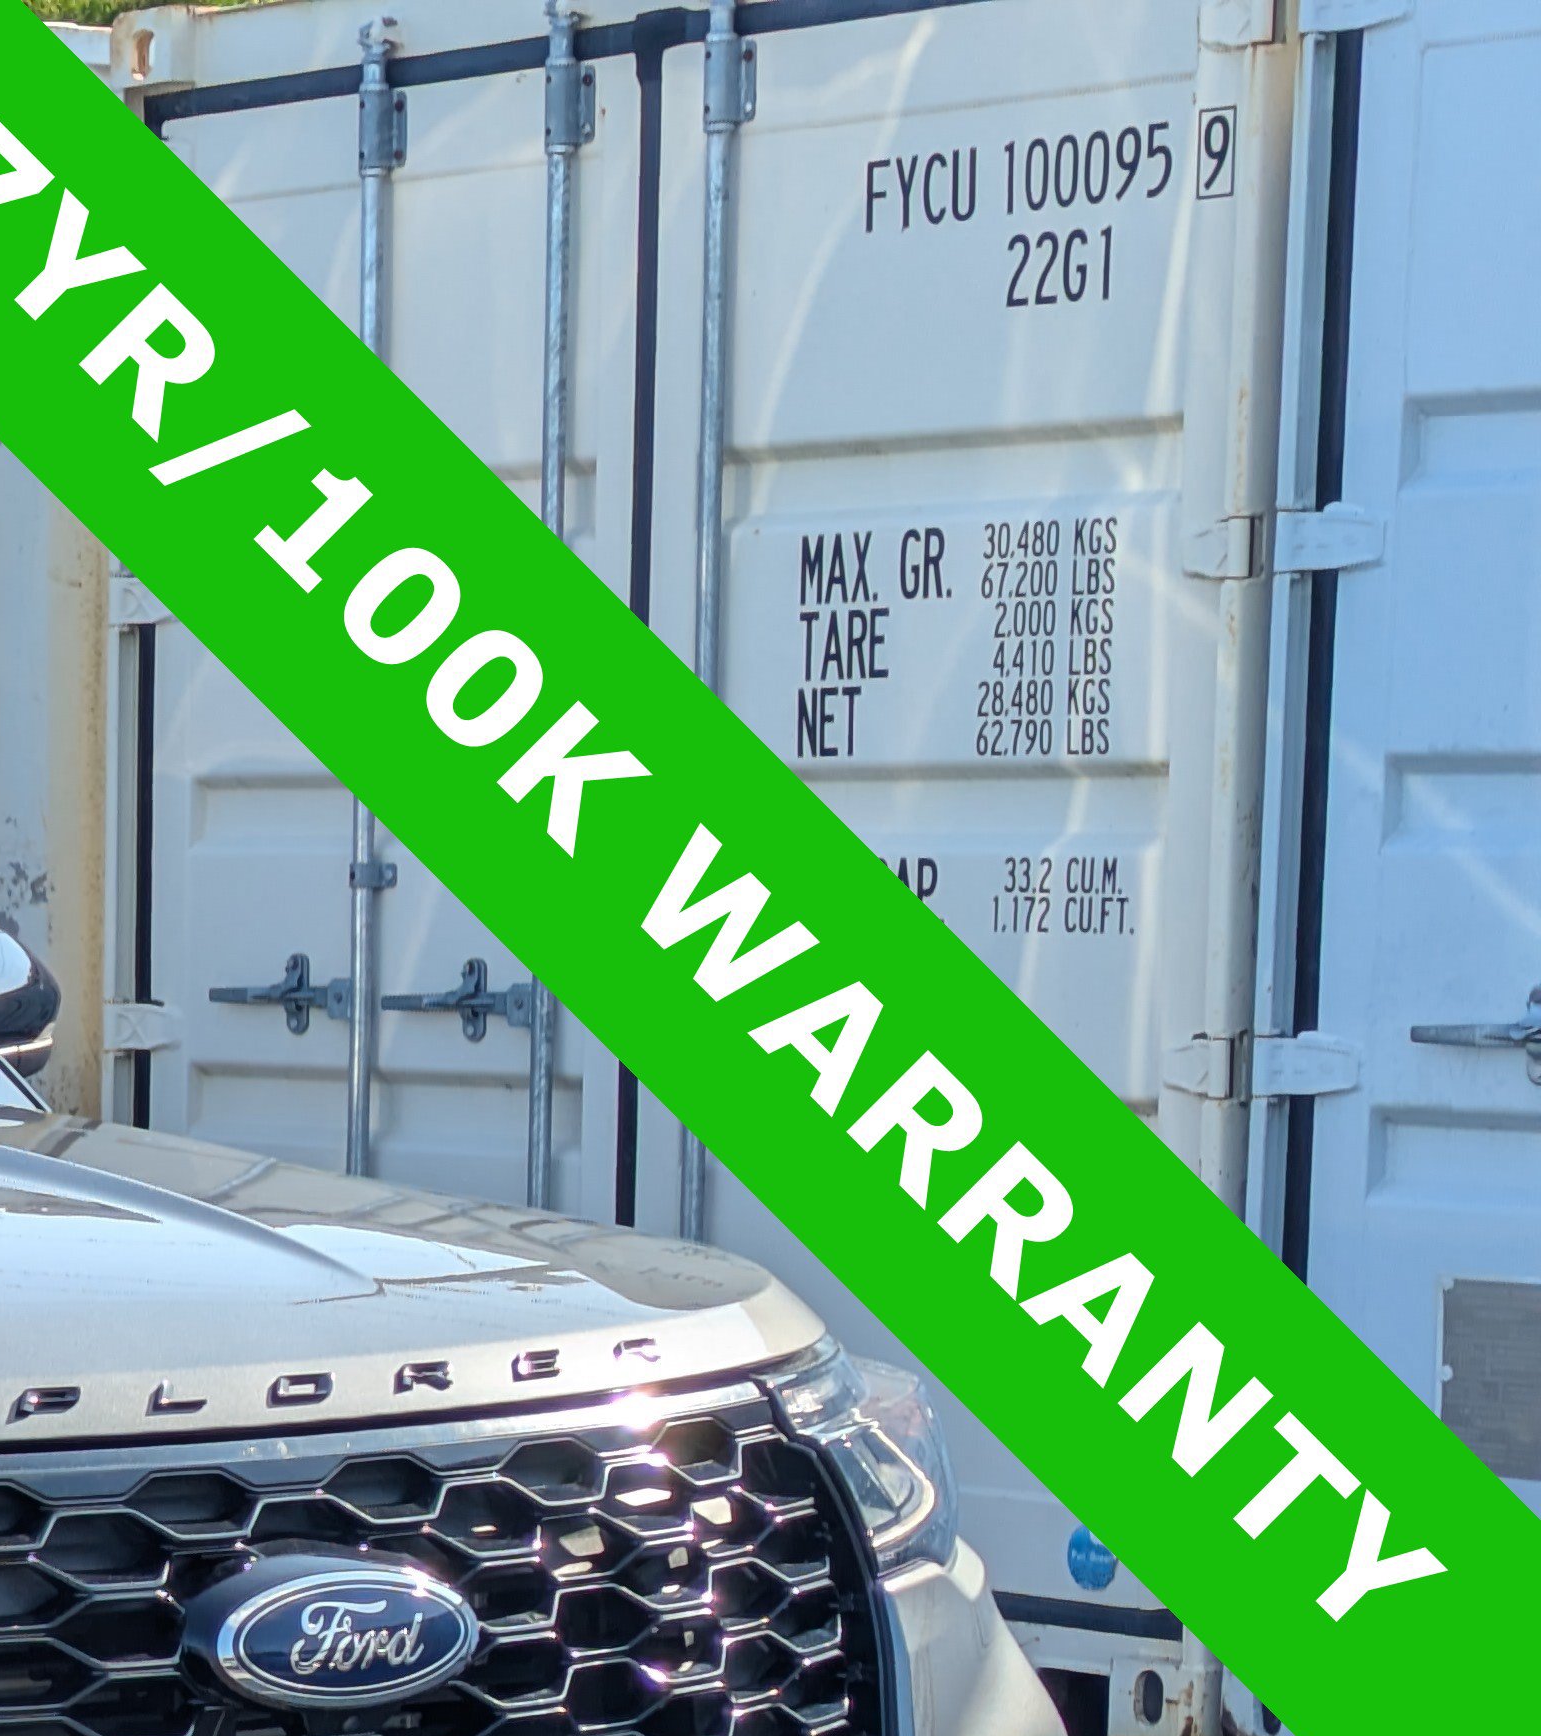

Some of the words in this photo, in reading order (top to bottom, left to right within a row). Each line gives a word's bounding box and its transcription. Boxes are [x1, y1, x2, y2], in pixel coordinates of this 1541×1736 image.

[865, 147, 978, 233] FYCU
[1003, 121, 1173, 216] 100095
[1204, 115, 1230, 191] 9
[1005, 225, 1113, 308] 22G1
[799, 530, 879, 607] MAX.
[899, 526, 953, 600] GR.
[1072, 516, 1118, 556] KGS
[1070, 557, 1116, 597] LBS
[799, 606, 890, 683] TARE
[1069, 597, 1115, 637] KGS
[1067, 637, 1113, 677] LBS
[796, 685, 863, 759] NET
[1066, 677, 1112, 717] KGS
[1066, 717, 1110, 756] LBS
[1003, 856, 1053, 895] 33.2
[1065, 856, 1123, 896] CU.M.
[1063, 896, 1135, 936] CU.FT.
[291, 1599, 426, 1676] Ford
